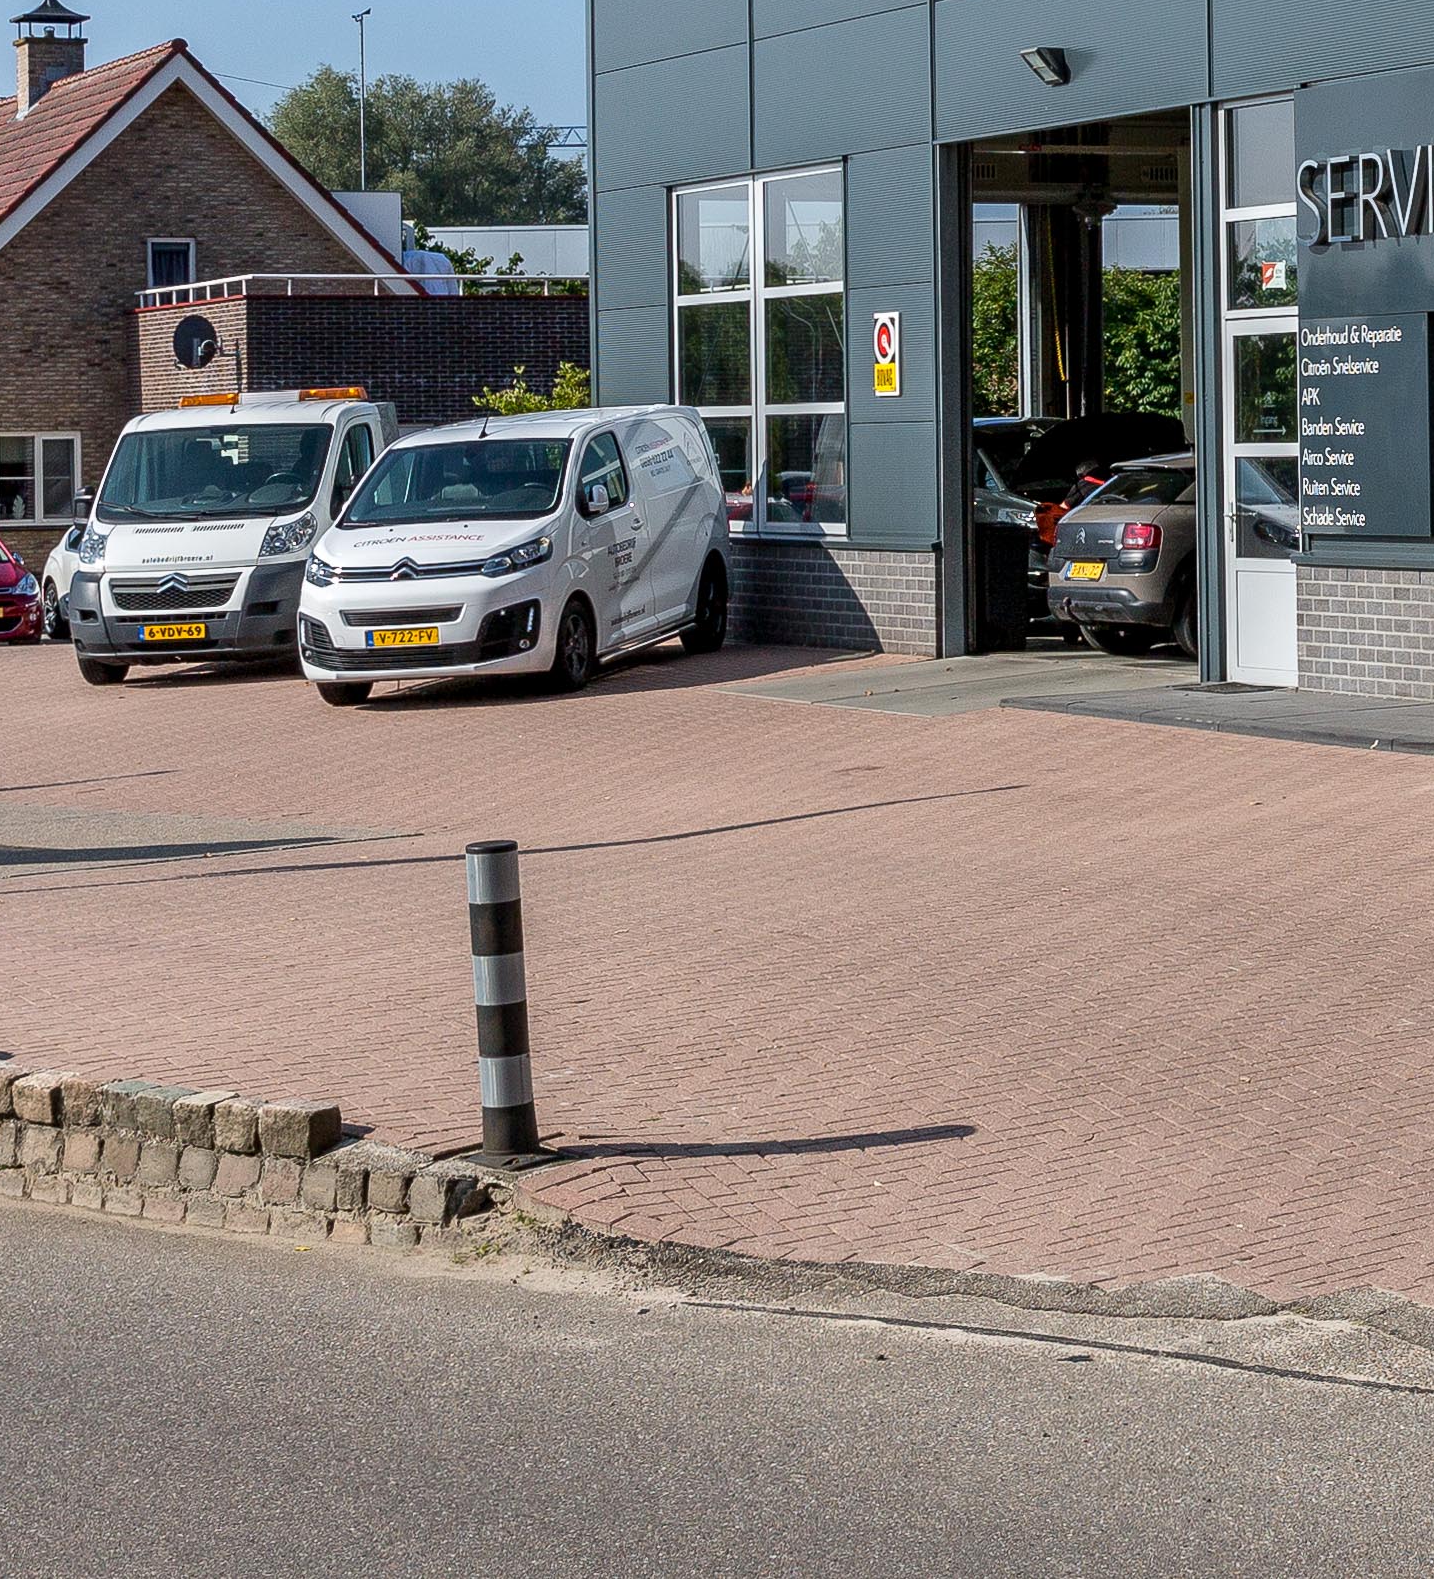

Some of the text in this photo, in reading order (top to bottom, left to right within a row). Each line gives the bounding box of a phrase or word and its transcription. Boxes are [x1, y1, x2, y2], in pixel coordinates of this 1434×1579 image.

[1301, 324, 1403, 348] Onderhoud & Reparatie
[1301, 354, 1380, 376] Citroën Snelservice
[1301, 387, 1322, 406] APK
[1301, 416, 1333, 436] Banden
[1334, 416, 1365, 436] Service
[1302, 446, 1355, 466] Airco Service
[1302, 477, 1361, 496] Ruiten Service
[1303, 506, 1366, 527] Schade Service
[407, 534, 486, 542] ASSISTANCE
[148, 625, 202, 639] 6-VDV-69
[379, 629, 434, 645] V-722-FV
